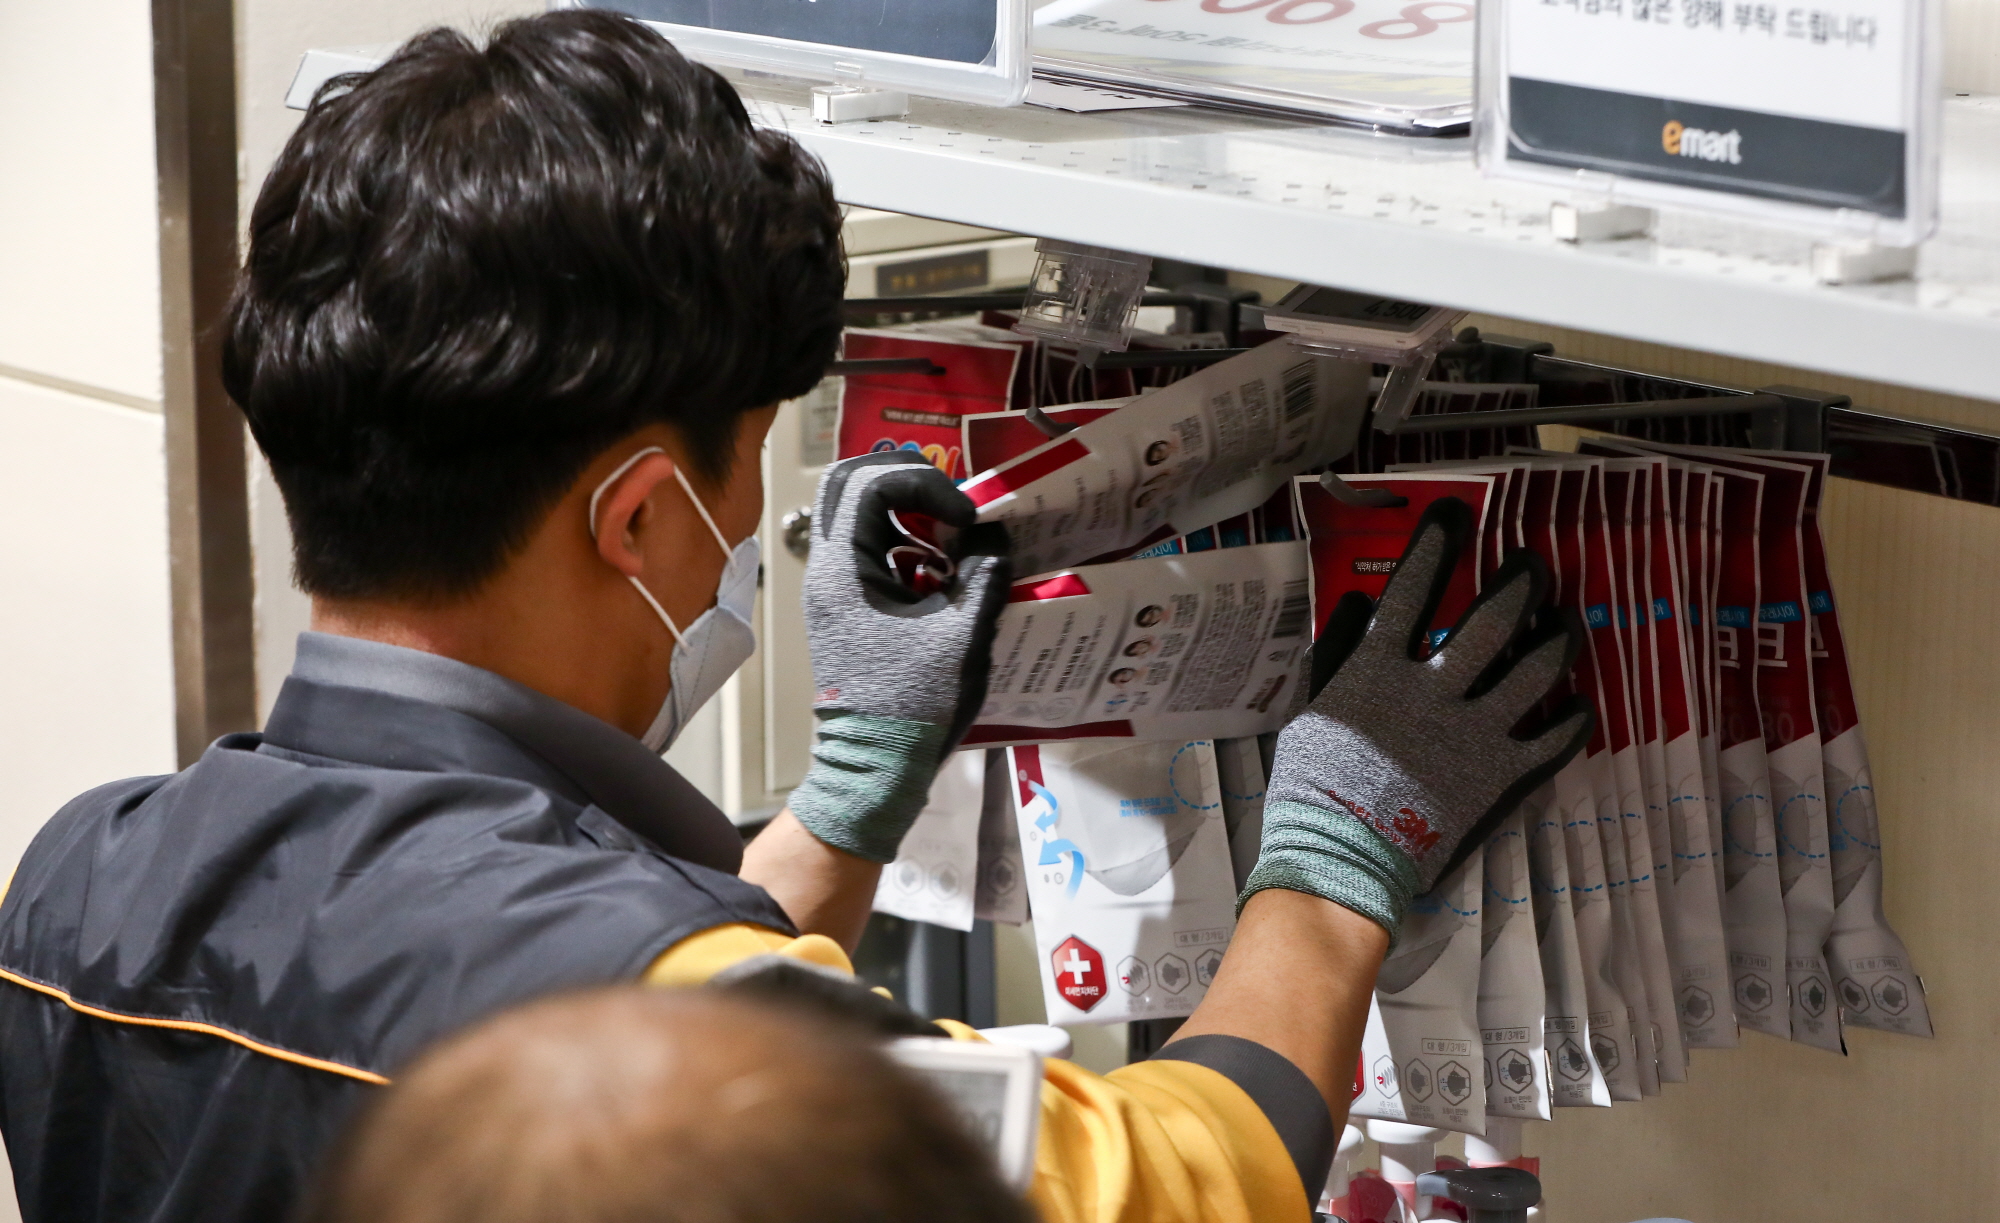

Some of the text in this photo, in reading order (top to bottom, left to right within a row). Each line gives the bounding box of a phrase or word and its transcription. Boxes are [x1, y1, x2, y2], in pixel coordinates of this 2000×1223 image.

[1683, 0, 1724, 30] 양해
[1734, 3, 1776, 37] 부탁
[1784, 8, 1877, 47] 드립니다
[1662, 120, 1742, 164] emart
[1363, 301, 1432, 320] 4,500
[1393, 807, 1441, 853] 3M
